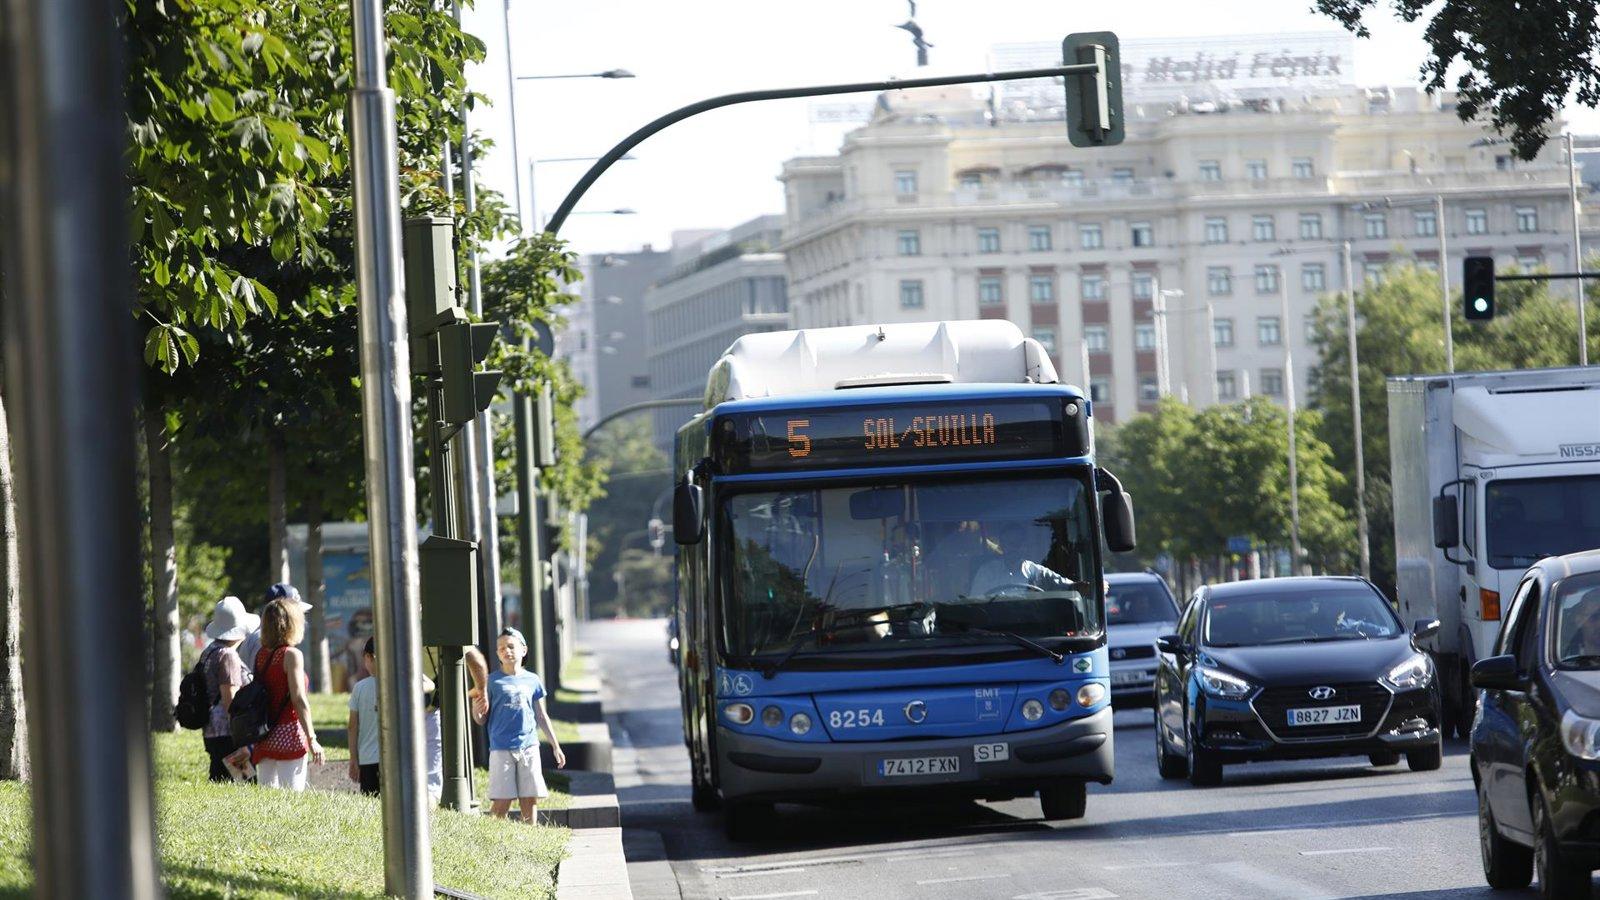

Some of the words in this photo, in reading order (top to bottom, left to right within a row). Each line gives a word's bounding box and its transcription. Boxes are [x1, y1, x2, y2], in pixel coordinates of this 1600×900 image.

[787, 419, 811, 457] 5
[975, 688, 1000, 698] EMT
[830, 709, 885, 728] 8254
[1296, 710, 1329, 723] 8827
[1335, 708, 1359, 720] JZN
[978, 745, 1004, 759] SP
[886, 760, 925, 775] 7412
[929, 758, 957, 773] FXN
